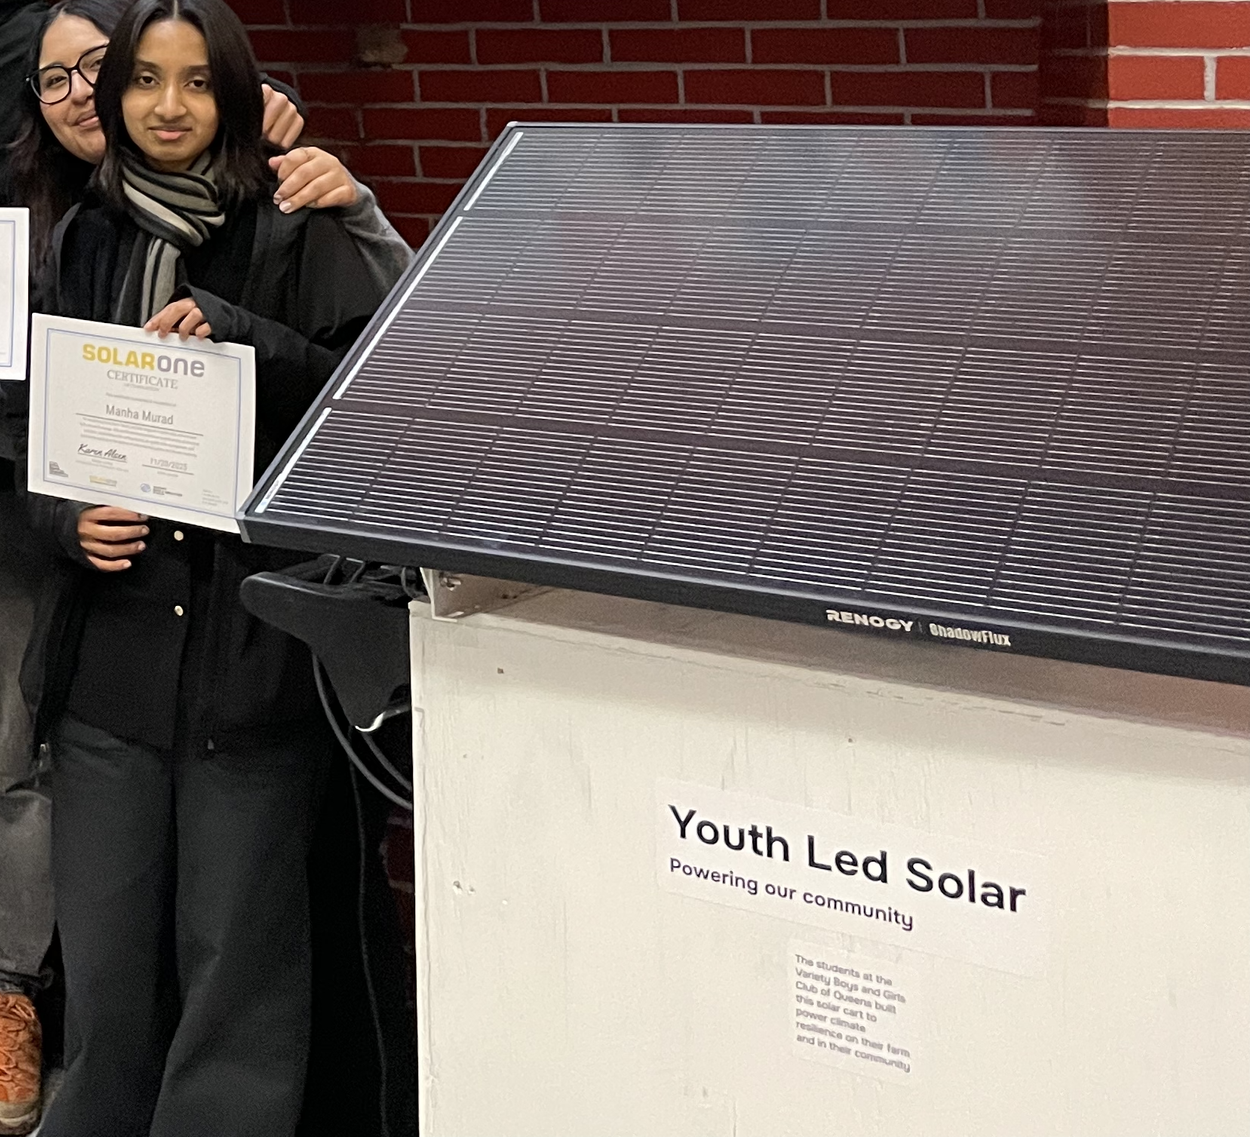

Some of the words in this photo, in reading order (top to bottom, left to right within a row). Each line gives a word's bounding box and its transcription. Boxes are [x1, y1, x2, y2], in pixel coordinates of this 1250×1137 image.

[107, 369, 178, 389] CERTIFICATE
[105, 404, 139, 420] Manha
[142, 410, 174, 425] Murad
[826, 609, 914, 632] RENOGY
[668, 804, 790, 862] Youth
[807, 834, 888, 883] Led
[906, 857, 1026, 912] Solar
[670, 857, 759, 895] Powering
[765, 881, 796, 900] our
[802, 889, 914, 932] community
[795, 954, 814, 967] The
[816, 961, 860, 978] students
[863, 973, 873, 982] at
[876, 975, 892, 986] the
[795, 967, 830, 986] Variety
[833, 976, 859, 992] Boys
[861, 986, 881, 997] and
[883, 990, 906, 1003] Girls
[795, 980, 818, 994] Club
[821, 988, 830, 997] of
[834, 990, 872, 1008] Queens
[875, 1000, 896, 1014] built
[796, 994, 814, 1006] this
[817, 1000, 840, 1012] solar
[843, 1007, 864, 1019] cart
[866, 1012, 877, 1022] to
[796, 1008, 827, 1022] power
[830, 1017, 866, 1033] climate
[796, 1021, 842, 1040] resilience
[845, 1034, 859, 1044] on
[861, 1037, 883, 1050] their
[887, 1043, 910, 1057] farm
[796, 1034, 815, 1045] and
[817, 1038, 827, 1048] in
[829, 1042, 851, 1055] their
[854, 1050, 910, 1073] community
